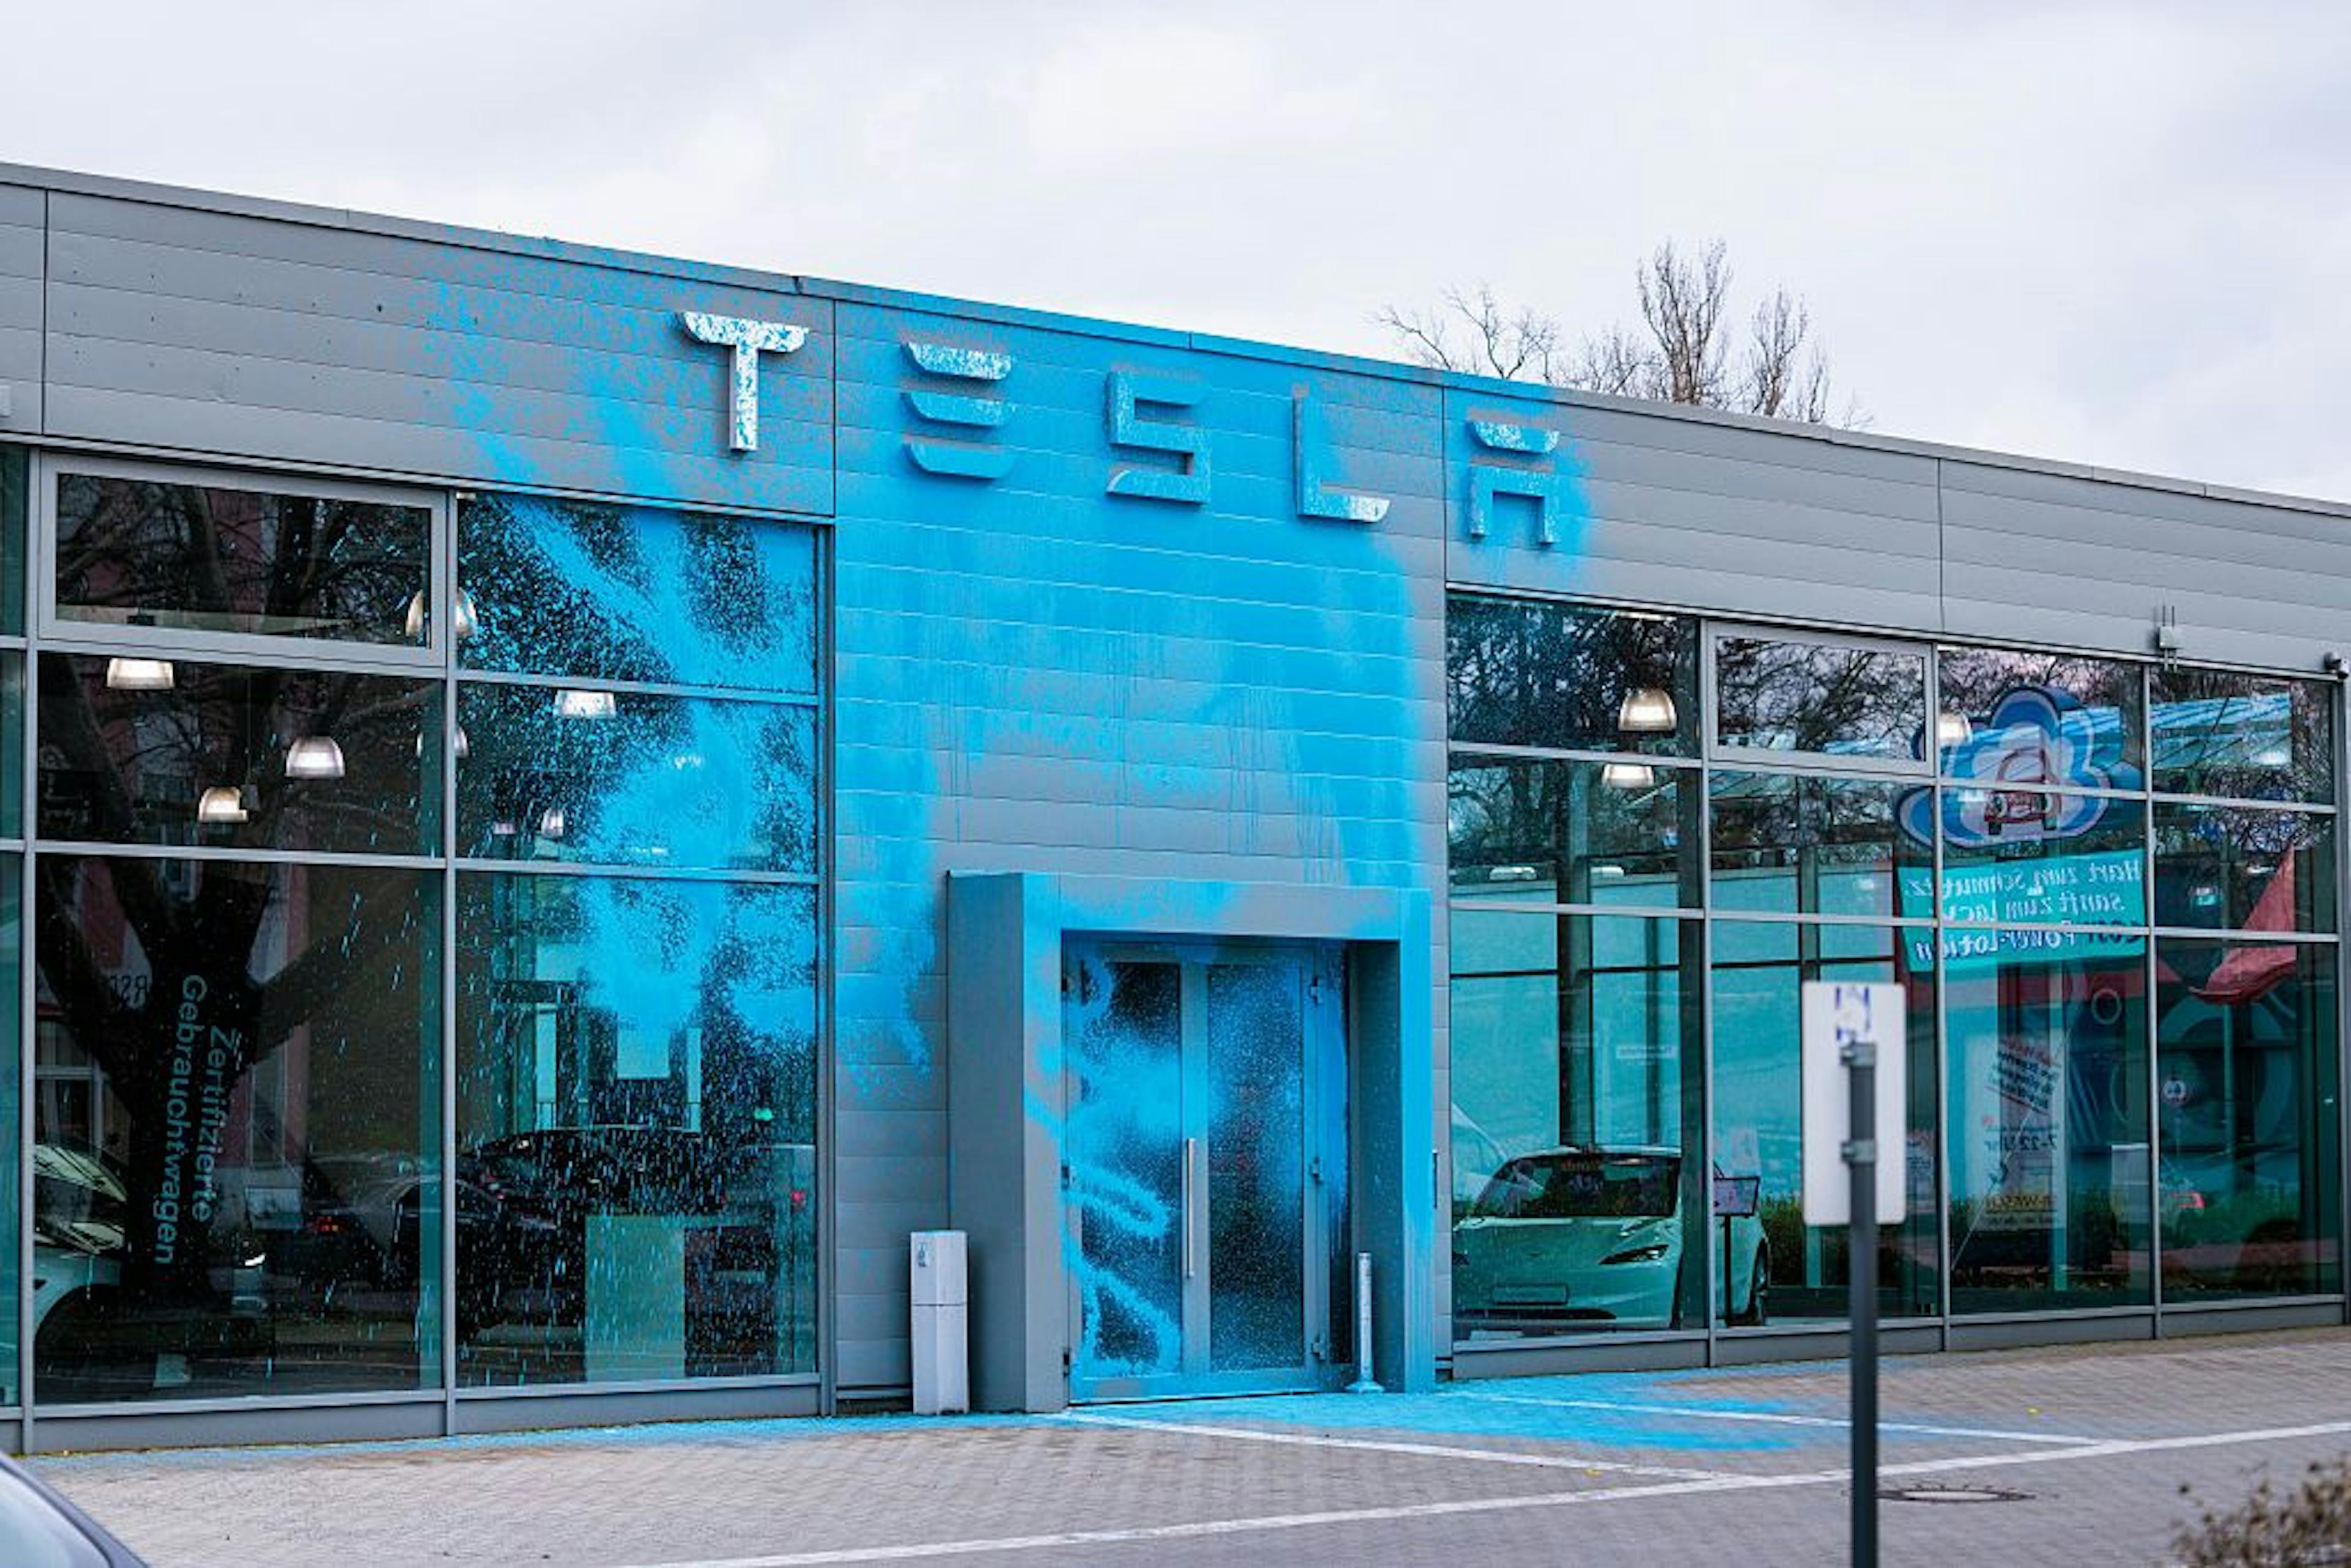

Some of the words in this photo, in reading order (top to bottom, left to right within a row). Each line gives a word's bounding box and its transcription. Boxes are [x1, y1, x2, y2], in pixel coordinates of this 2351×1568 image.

[674, 310, 1560, 544] TESLA
[153, 974, 208, 1264] Gebrauchtwagen
[192, 1024, 241, 1223] Zertifizierte
